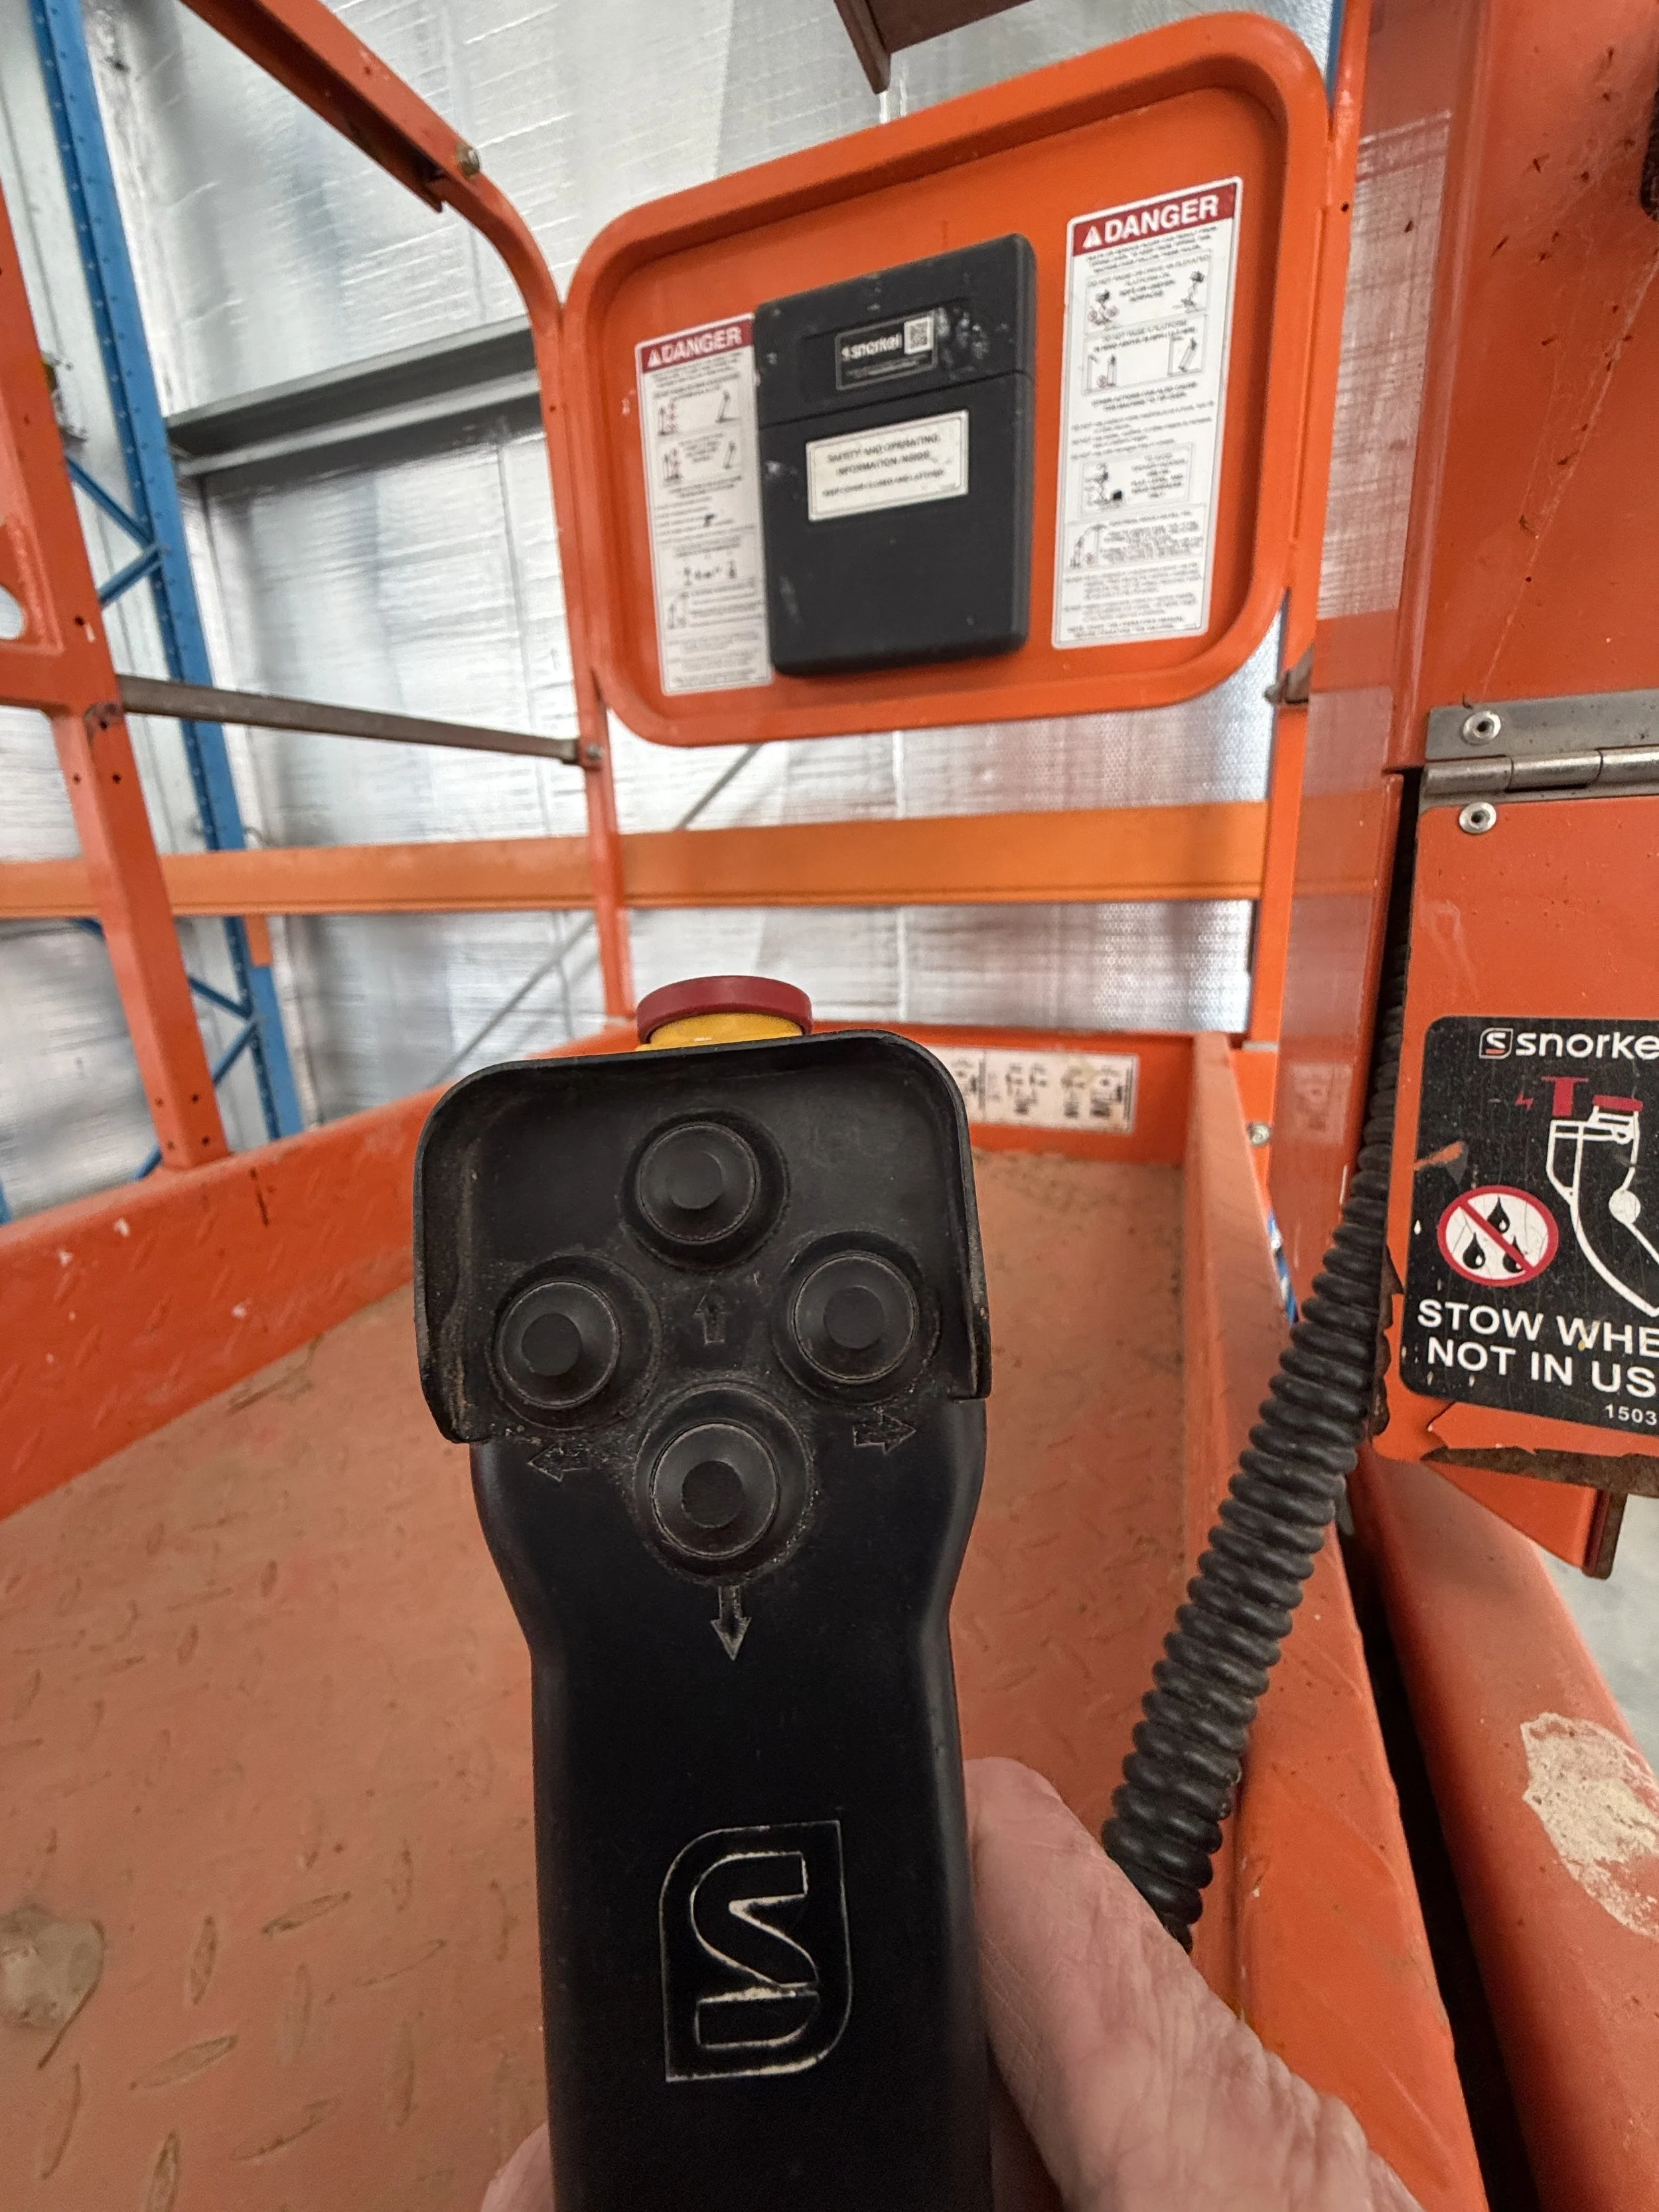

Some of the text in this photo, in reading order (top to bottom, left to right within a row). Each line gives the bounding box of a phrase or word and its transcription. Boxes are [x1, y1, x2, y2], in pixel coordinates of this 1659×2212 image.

[1104, 194, 1219, 244] DANGER
[660, 326, 743, 364] DANGER
[1417, 1299, 1659, 1359] STOW WHE
[1427, 1337, 1657, 1398] NOT IN US
[1605, 1404, 1657, 1426] 1503
